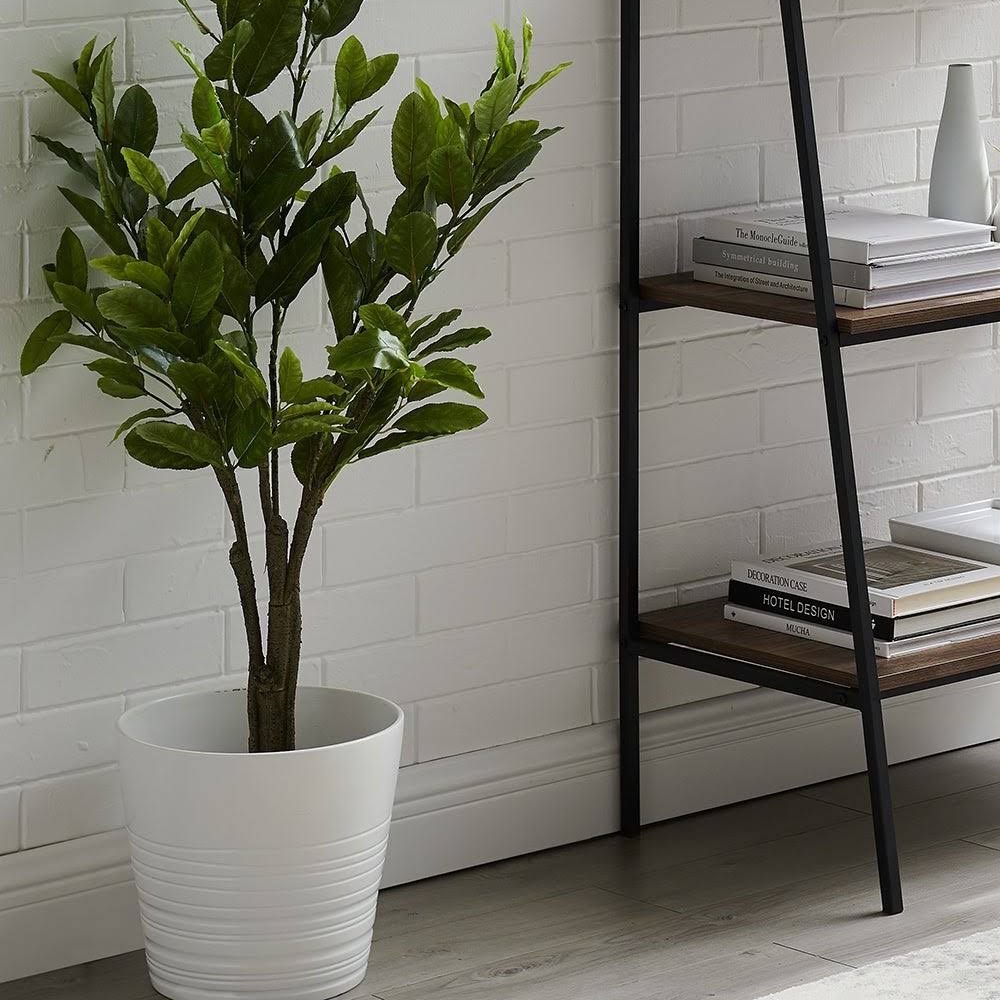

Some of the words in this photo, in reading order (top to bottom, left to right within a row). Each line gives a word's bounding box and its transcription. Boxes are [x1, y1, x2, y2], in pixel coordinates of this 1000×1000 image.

[735, 227, 749, 240] The
[721, 249, 766, 265] Symmetrical
[714, 270, 723, 279] The
[724, 272, 749, 284] Integration
[755, 276, 769, 287] Street
[770, 279, 779, 288] and
[779, 281, 808, 293] Architecture
[747, 568, 790, 590] DECORATION
[789, 579, 808, 592] CASE
[762, 593, 795, 612] HOTEL
[797, 602, 835, 621] DESIGN
[786, 623, 810, 636] MUCHA
